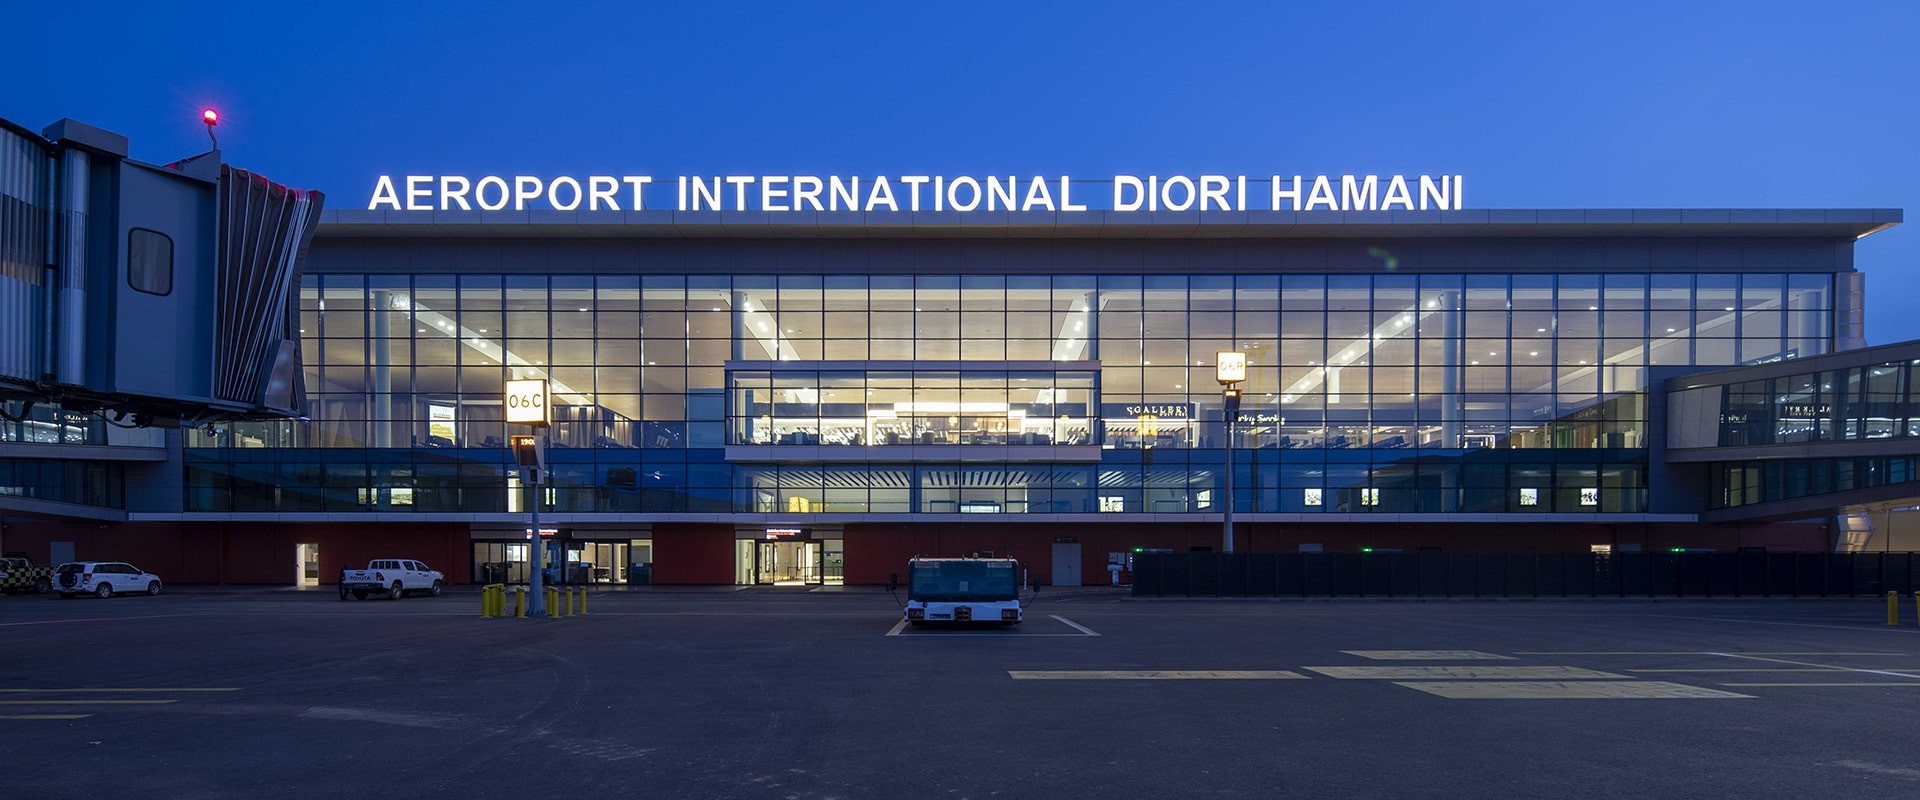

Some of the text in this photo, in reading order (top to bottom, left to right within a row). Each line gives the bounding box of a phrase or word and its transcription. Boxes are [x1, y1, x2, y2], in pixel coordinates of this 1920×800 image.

[368, 175, 1462, 211] AEROPORT INTERNATIONAL DIORI HAMANI
[509, 394, 541, 408] 06C
